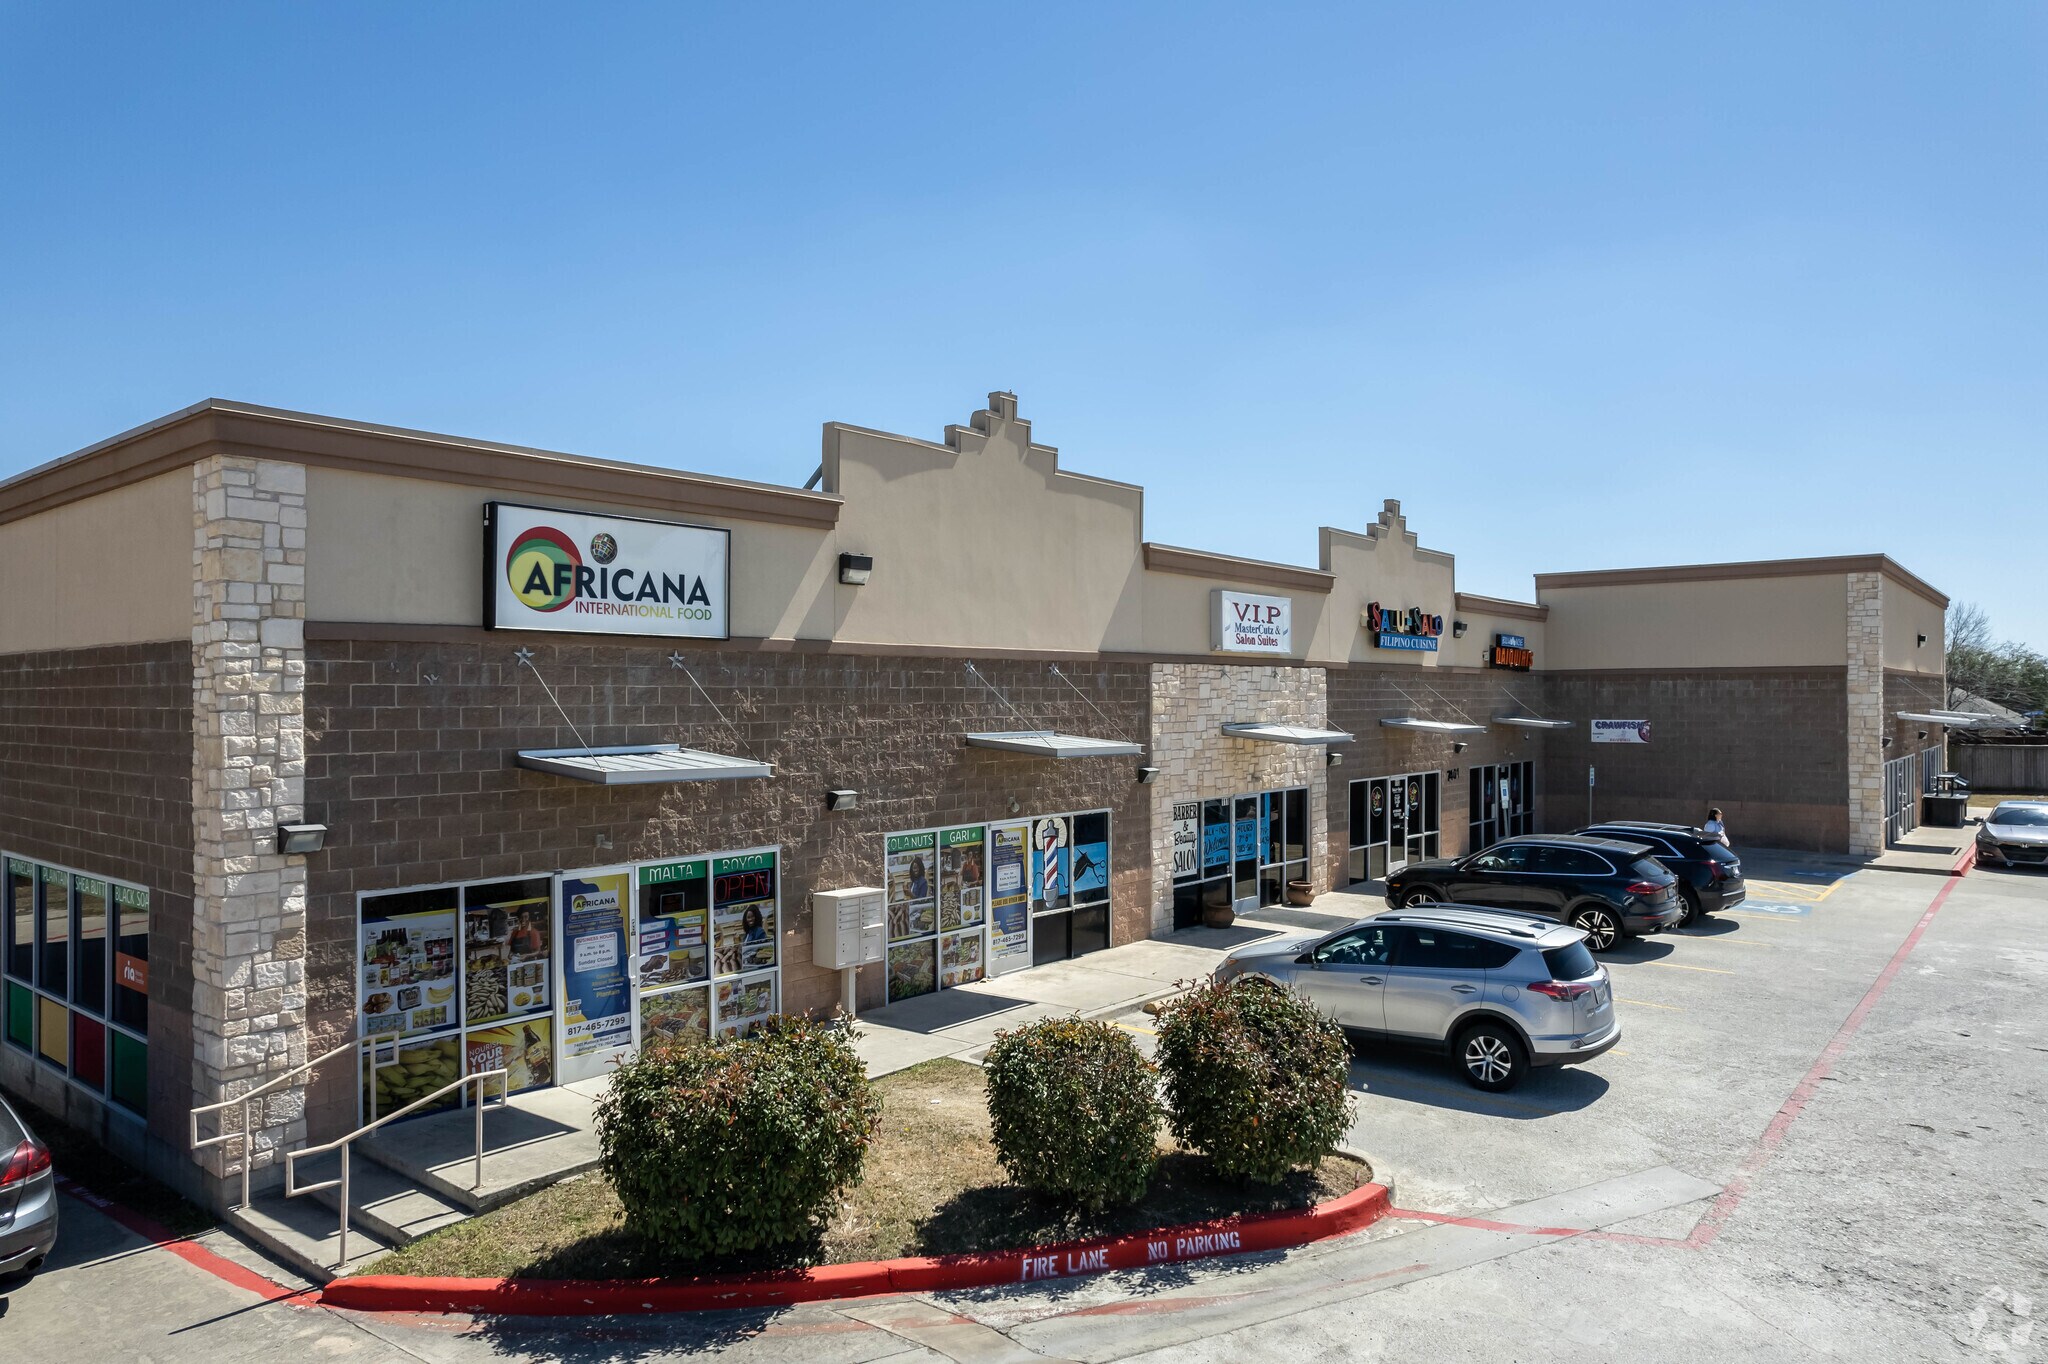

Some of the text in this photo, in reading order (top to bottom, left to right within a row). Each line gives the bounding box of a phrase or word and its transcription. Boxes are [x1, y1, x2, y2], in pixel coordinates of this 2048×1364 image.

[522, 560, 711, 606] AFRICANA
[575, 601, 712, 621] INTERNATIONAL FOOD
[1232, 602, 1281, 624] V.I.P
[1235, 622, 1281, 635] MasterCutz &
[1236, 633, 1278, 646] Salon Suites
[1381, 635, 1437, 649] FILIPINO CUISINE
[1595, 720, 1644, 730] CRAWFISH
[1173, 804, 1198, 821] BARBER
[1183, 821, 1189, 832] &
[911, 834, 934, 847] NUTS
[949, 829, 970, 843] GARI
[1174, 849, 1198, 873] SALON
[649, 864, 693, 882] MALTA
[75, 876, 90, 892] SHEA
[714, 872, 769, 902] OPEN
[115, 886, 135, 905] BLACK
[576, 897, 616, 909] AFRICANA
[576, 936, 599, 944] BUSINESS
[124, 960, 135, 981] ria
[567, 1016, 626, 1036] 817-465-7299
[469, 1041, 502, 1057] NOURISH
[469, 1046, 503, 1066] YOUR
[1147, 1231, 1241, 1261] NO PARKING
[1021, 1248, 1109, 1282] FIRE LANE
